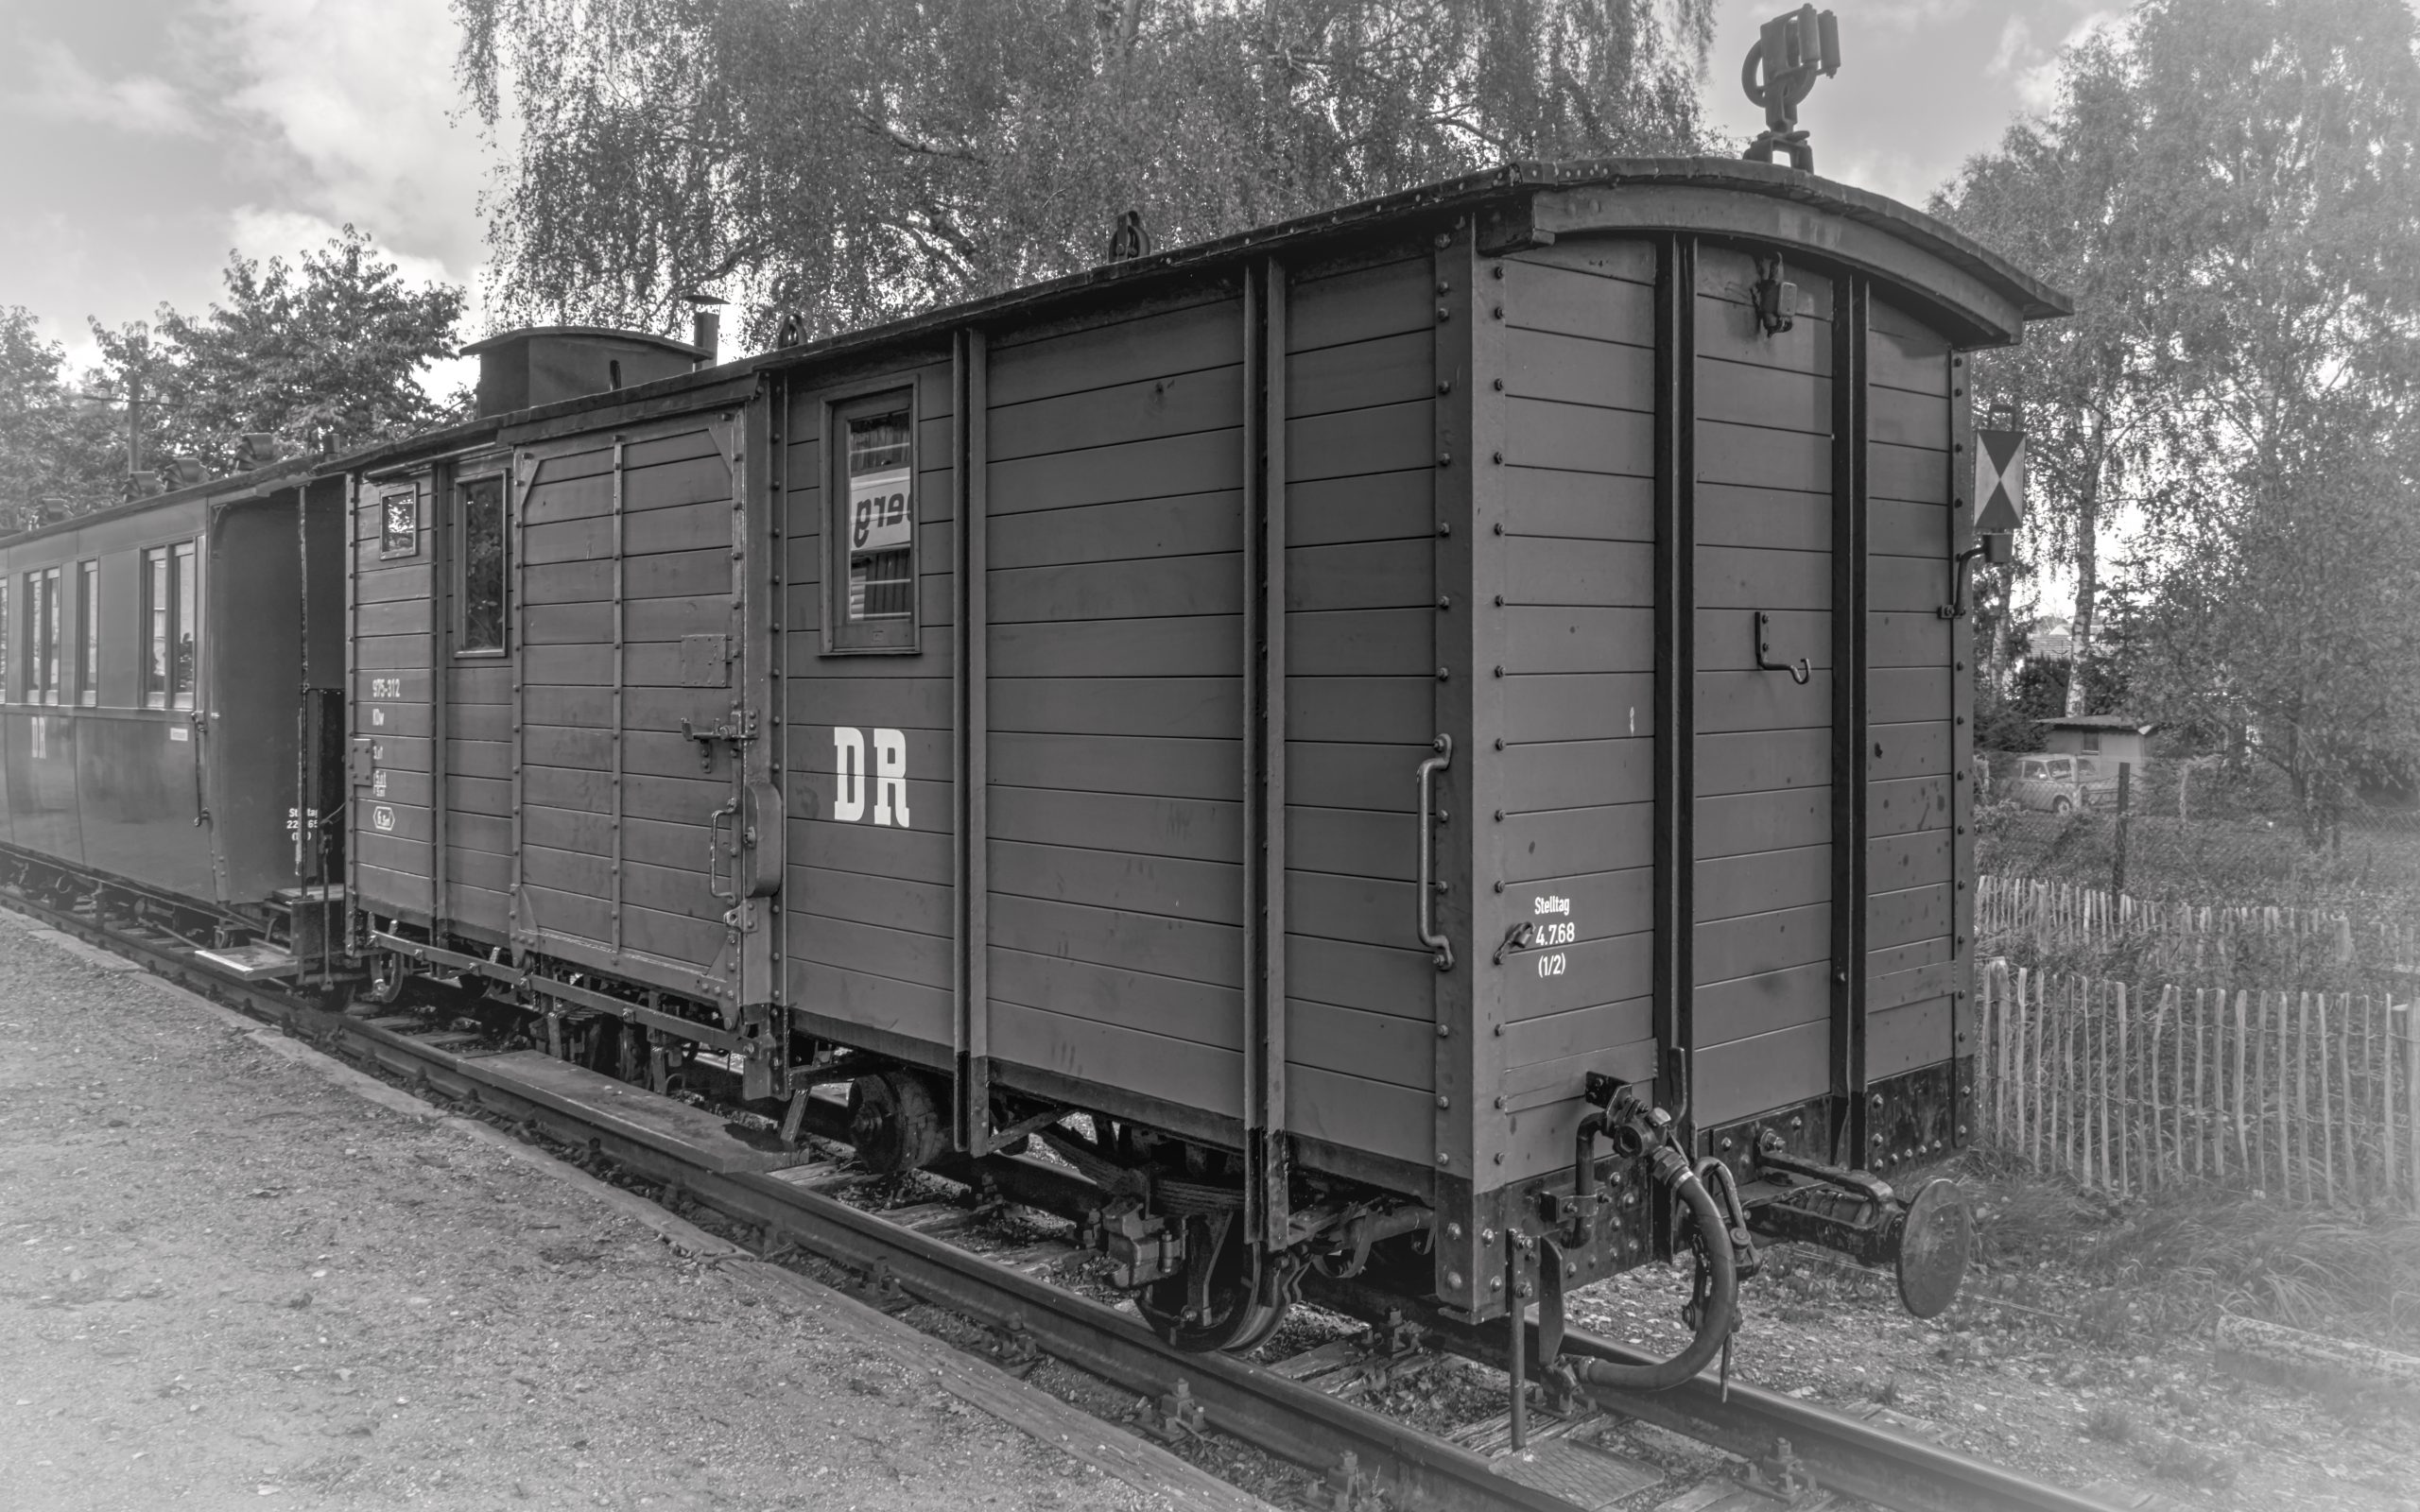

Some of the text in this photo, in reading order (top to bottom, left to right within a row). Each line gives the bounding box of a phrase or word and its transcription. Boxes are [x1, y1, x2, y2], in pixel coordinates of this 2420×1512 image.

[834, 726, 910, 828] DR
[1534, 896, 1570, 916] Stelltag
[1538, 952, 1566, 978] (1/2)
